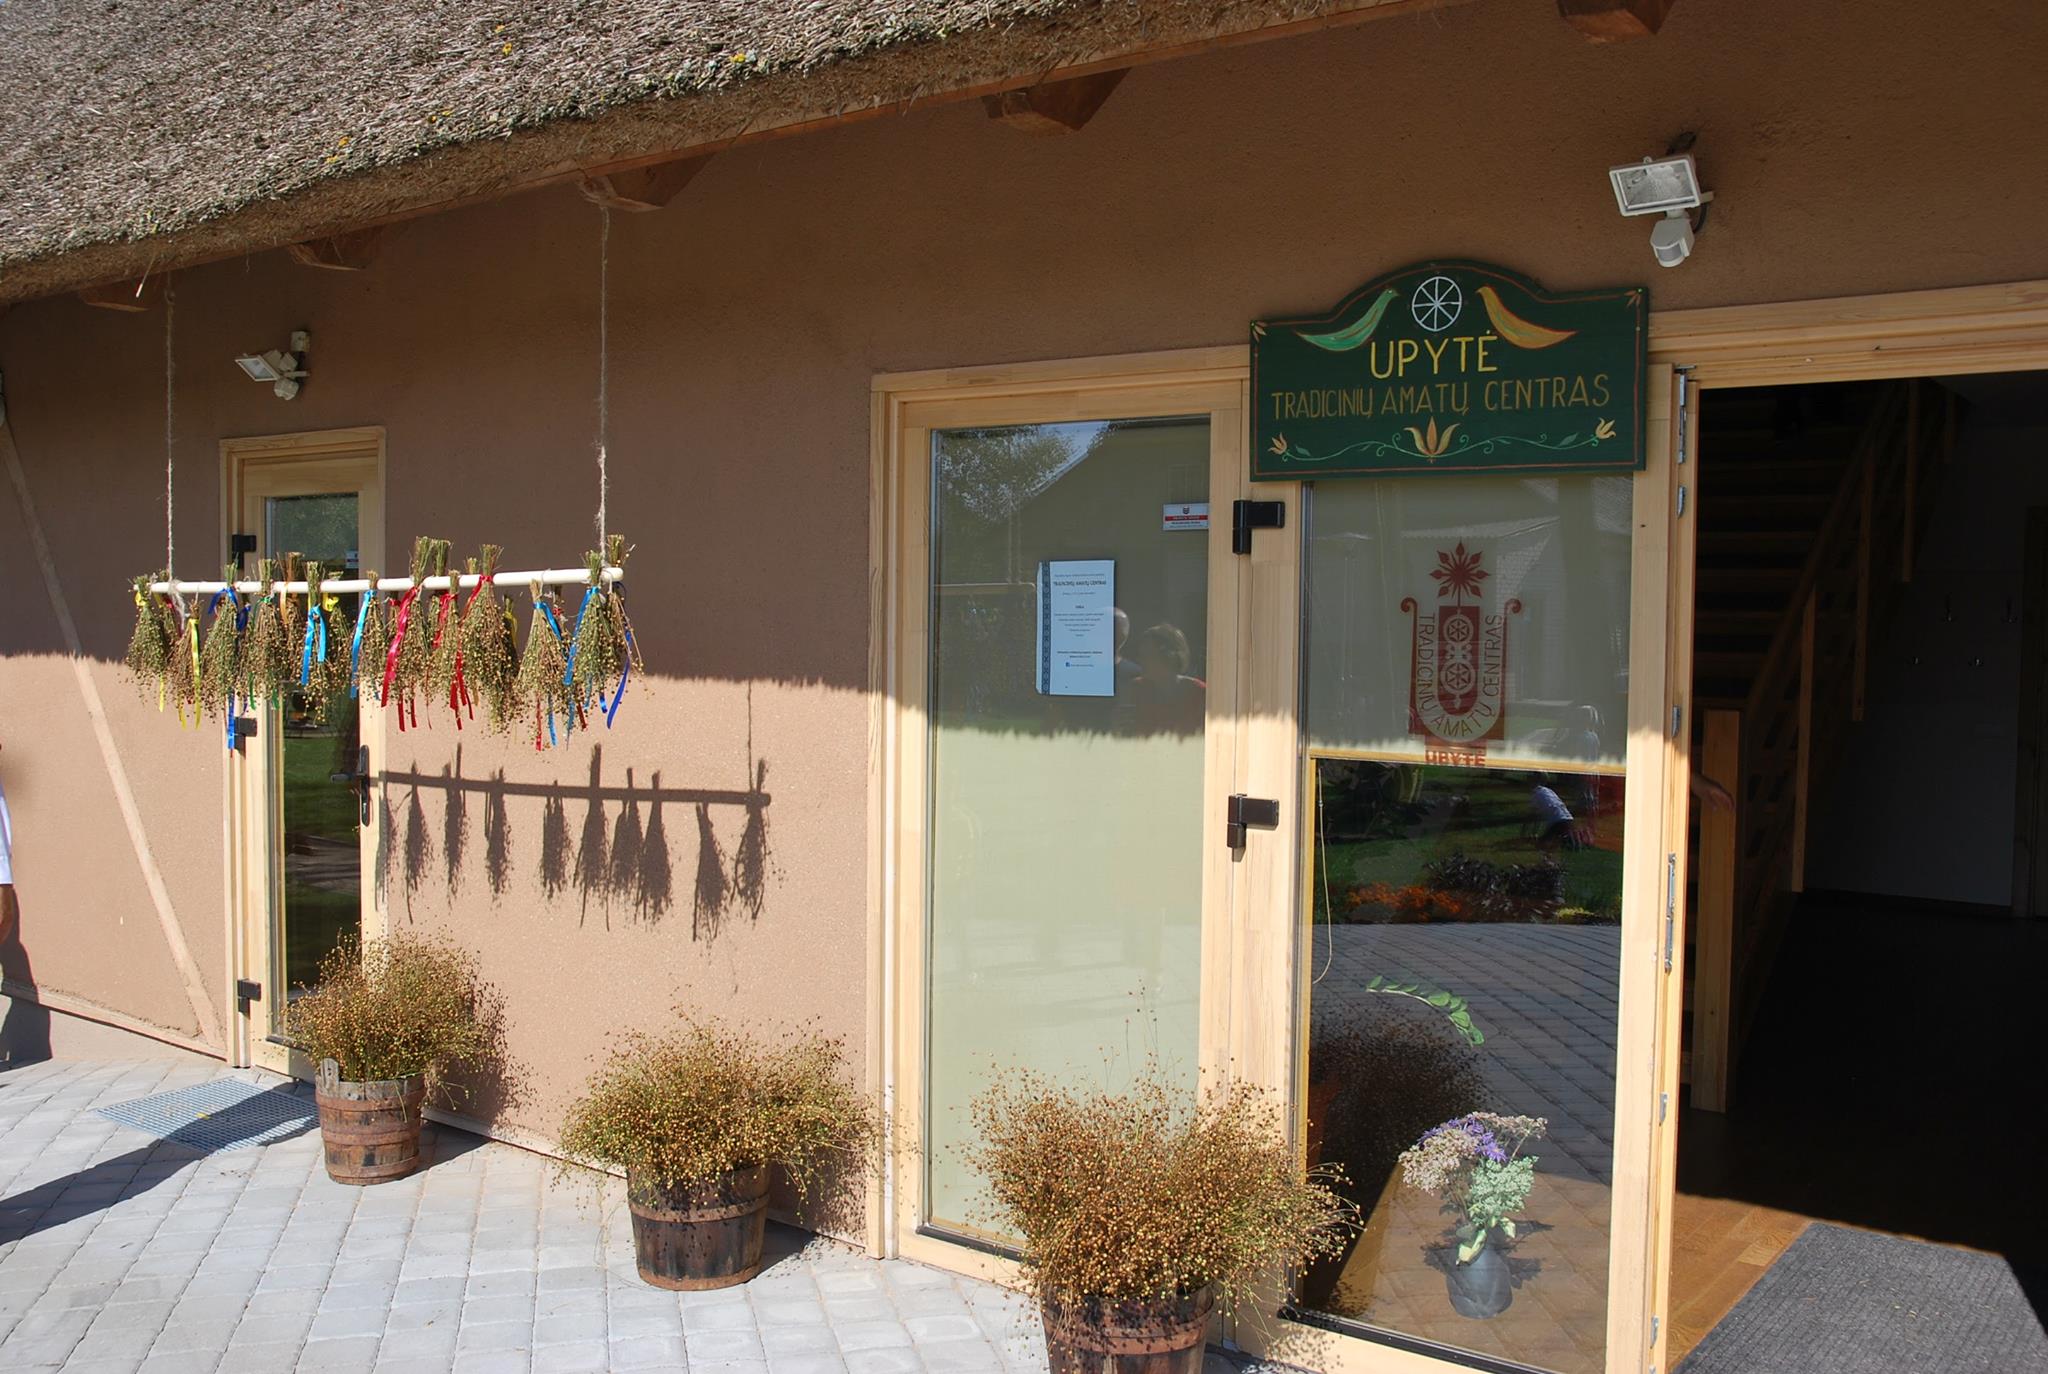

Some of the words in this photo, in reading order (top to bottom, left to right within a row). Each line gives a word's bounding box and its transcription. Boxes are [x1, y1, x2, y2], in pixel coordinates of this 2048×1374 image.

[1370, 329, 1499, 380] UPYTĖ
[1271, 388, 1374, 420] TRADICINIŲ
[1381, 382, 1470, 417] AMATŲ
[1484, 373, 1611, 412] CENTRAS
[1416, 612, 1438, 713] TRADICINIŲ
[1431, 702, 1496, 738] AMATŲ
[1482, 615, 1504, 697] CENTRAS
